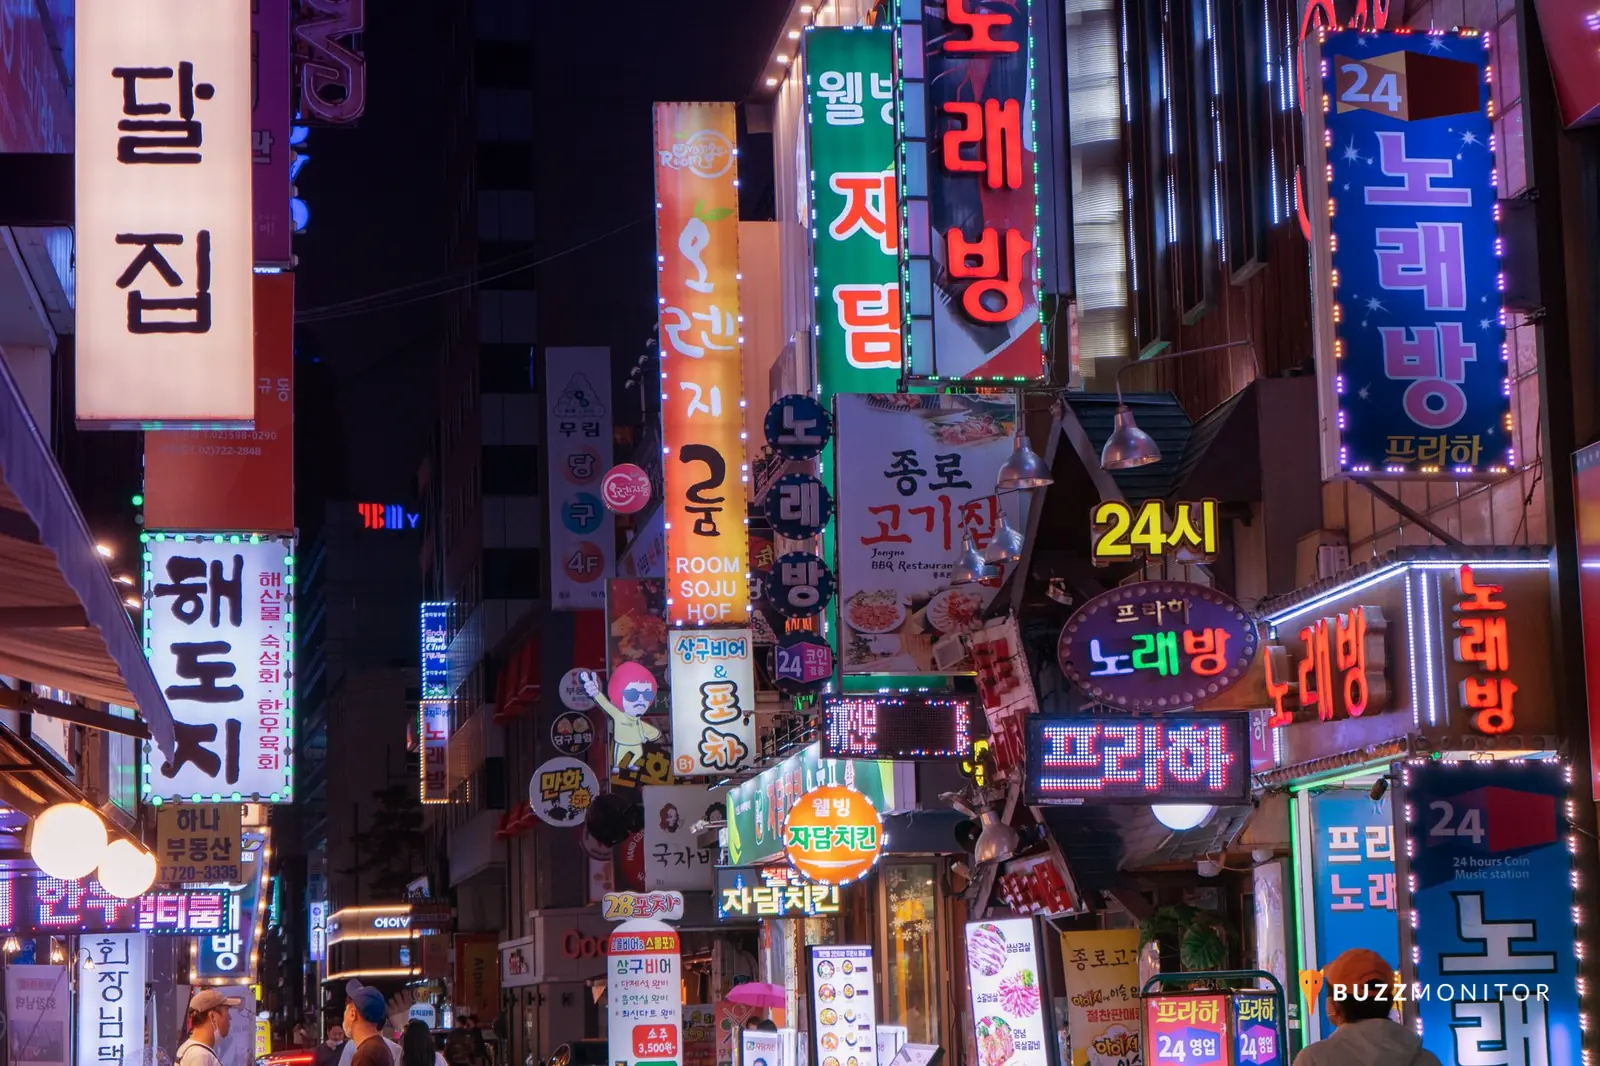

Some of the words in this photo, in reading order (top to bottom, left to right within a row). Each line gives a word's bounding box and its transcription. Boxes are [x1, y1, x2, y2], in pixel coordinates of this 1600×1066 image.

[1340, 63, 1402, 112] 24
[943, 0, 1032, 322] 노래방
[111, 60, 215, 334] 달집
[1364, 130, 1478, 430] 노래방
[559, 421, 601, 438] 무림
[1384, 434, 1483, 467] 프라하
[883, 449, 973, 497] 종로
[777, 404, 824, 607] 노래방
[1095, 499, 1217, 557] 24시
[567, 551, 601, 577] 4F
[676, 556, 740, 574] ROOM
[871, 560, 894, 572] BBQ
[898, 560, 955, 572] Restauran
[680, 580, 737, 598] SOJU
[687, 603, 731, 620] HOF
[1115, 598, 1192, 626] 프라하
[675, 636, 748, 664] 상구비어
[778, 650, 802, 678] 24
[805, 649, 828, 665] 코인
[1089, 627, 1232, 677] 노래방
[1456, 563, 1519, 736] 노래방
[152, 553, 245, 786] 해도지
[714, 664, 727, 679] &
[1263, 605, 1370, 729] 노래방
[700, 680, 748, 772] 포차
[679, 756, 693, 771] B1
[1040, 725, 1235, 792] 프라하
[176, 807, 220, 833] 하나
[811, 797, 850, 817] 웰빙
[1429, 800, 1486, 844] 24
[166, 837, 232, 862] 부동산
[788, 825, 877, 851] 자담치킨
[160, 864, 239, 881] T.720-3335
[1453, 856, 1467, 868] 24
[1469, 855, 1502, 868] hours
[1504, 855, 1531, 868] Coin
[1454, 868, 1487, 881] Music
[1489, 869, 1531, 881] station
[722, 884, 840, 915] 자담치킨
[617, 958, 672, 974] 상구비어
[1156, 1000, 1220, 1025] 프라하
[1238, 997, 1275, 1023] 프라하
[1158, 1035, 1187, 1062] 24
[1188, 1037, 1217, 1057] 영업
[1240, 1033, 1257, 1061] 24
[1258, 1035, 1273, 1054] 영업
